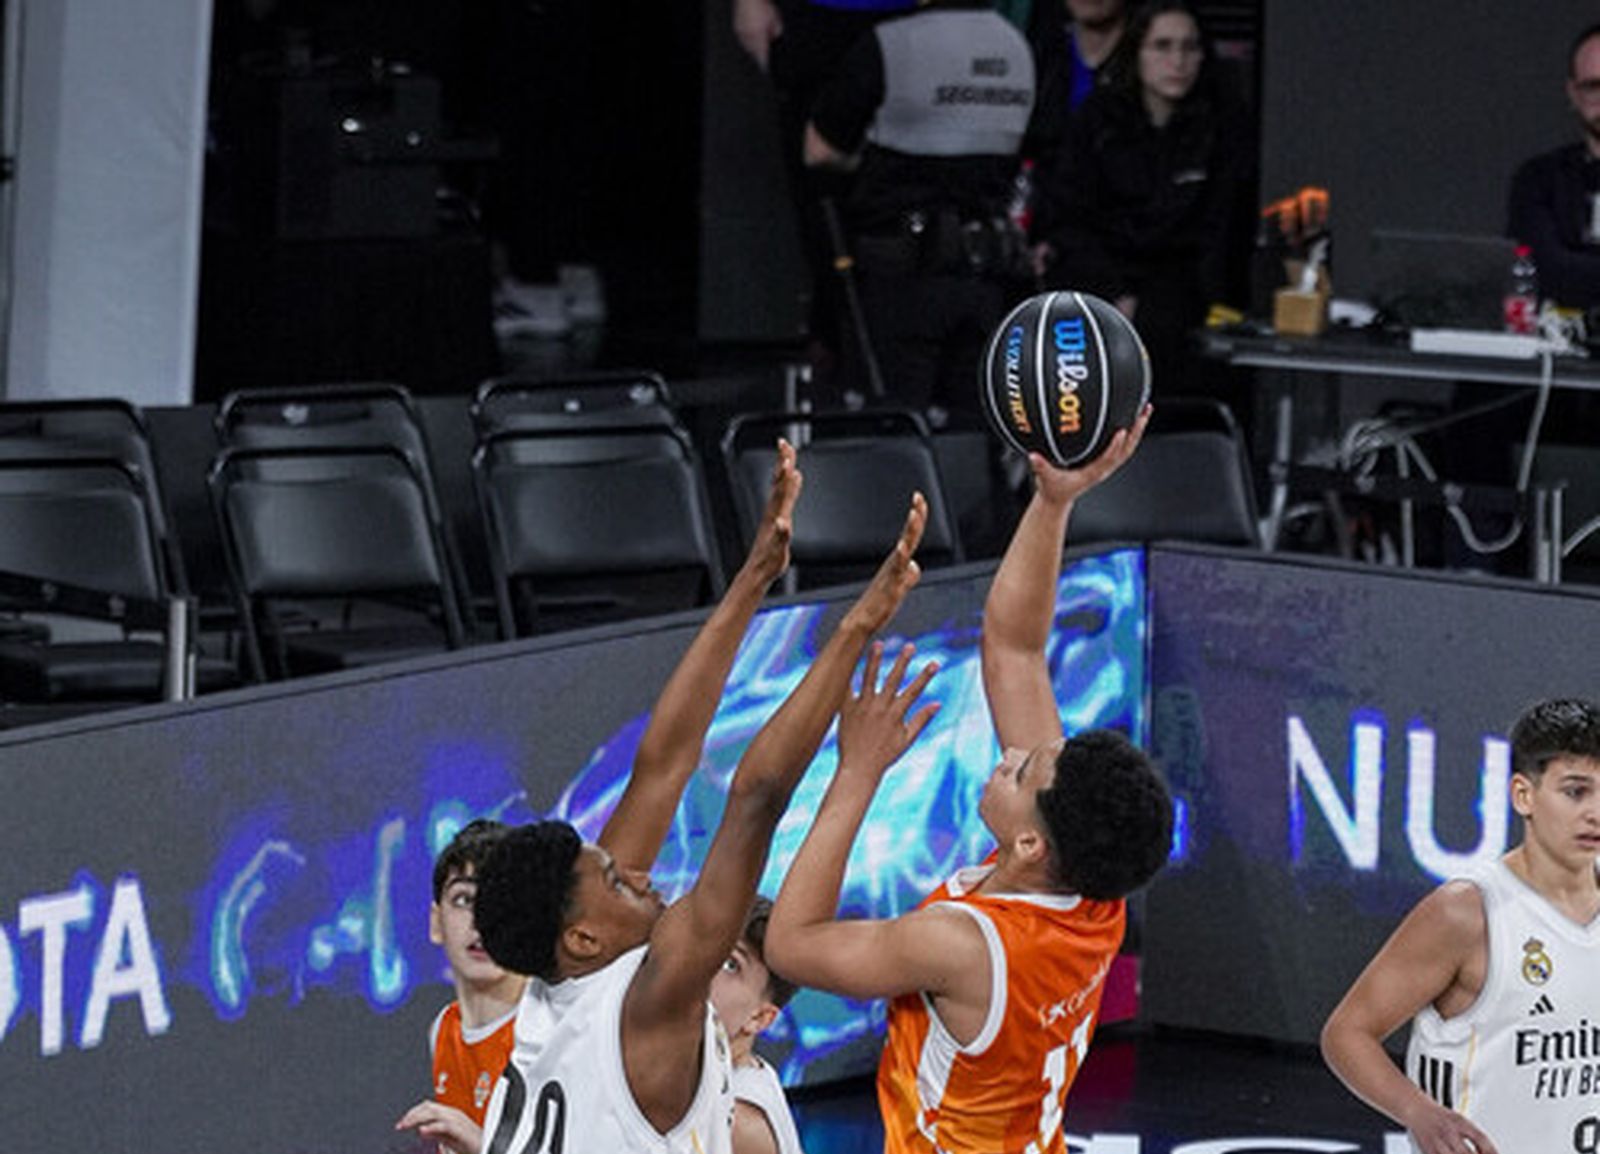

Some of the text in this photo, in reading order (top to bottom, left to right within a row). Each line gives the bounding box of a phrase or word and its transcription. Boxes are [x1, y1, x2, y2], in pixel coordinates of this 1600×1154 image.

[1054, 317, 1088, 434] Wilson
[0, 878, 171, 1057] TA
[1535, 1067, 1573, 1099] FLY
